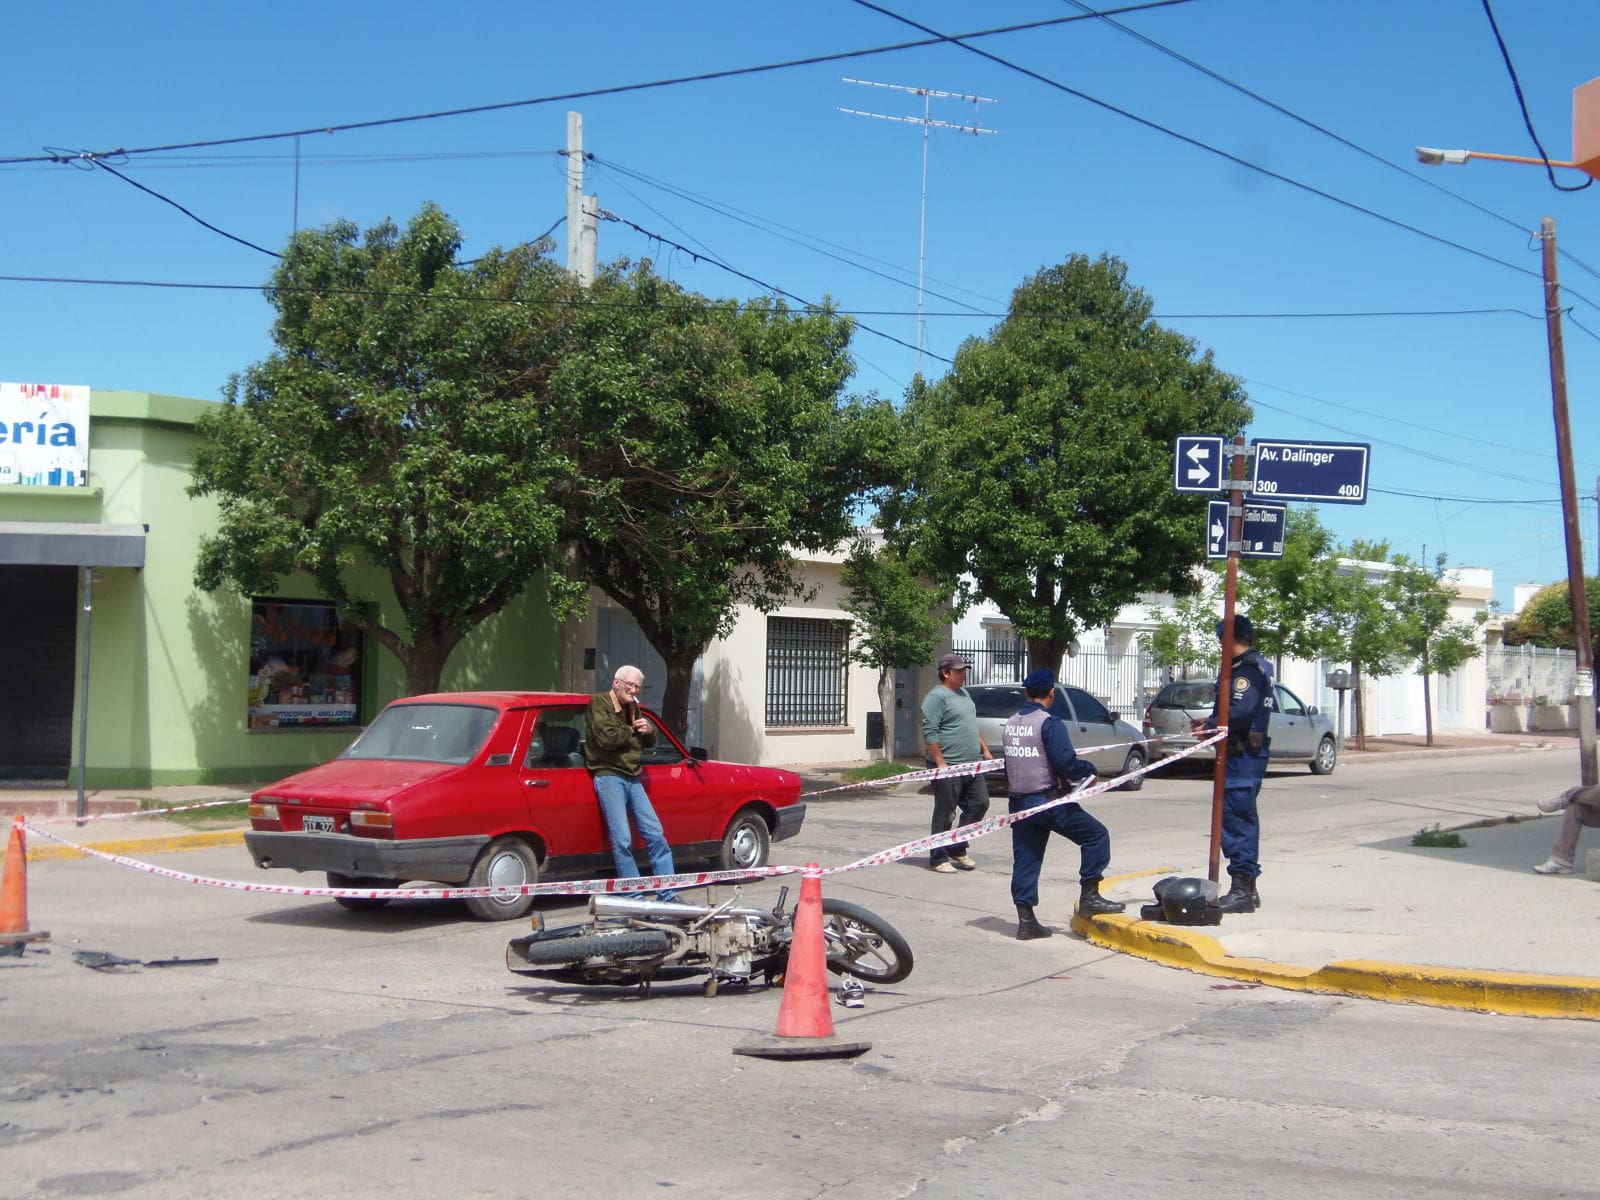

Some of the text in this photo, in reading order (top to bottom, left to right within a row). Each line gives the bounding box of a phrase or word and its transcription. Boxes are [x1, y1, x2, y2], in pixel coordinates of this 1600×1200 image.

[1260, 447, 1335, 466] Av. Dalinger
[1257, 480, 1278, 493] 300
[1338, 484, 1360, 497] 400
[1005, 725, 1033, 737] POLICIA
[1012, 738, 1020, 746] DE
